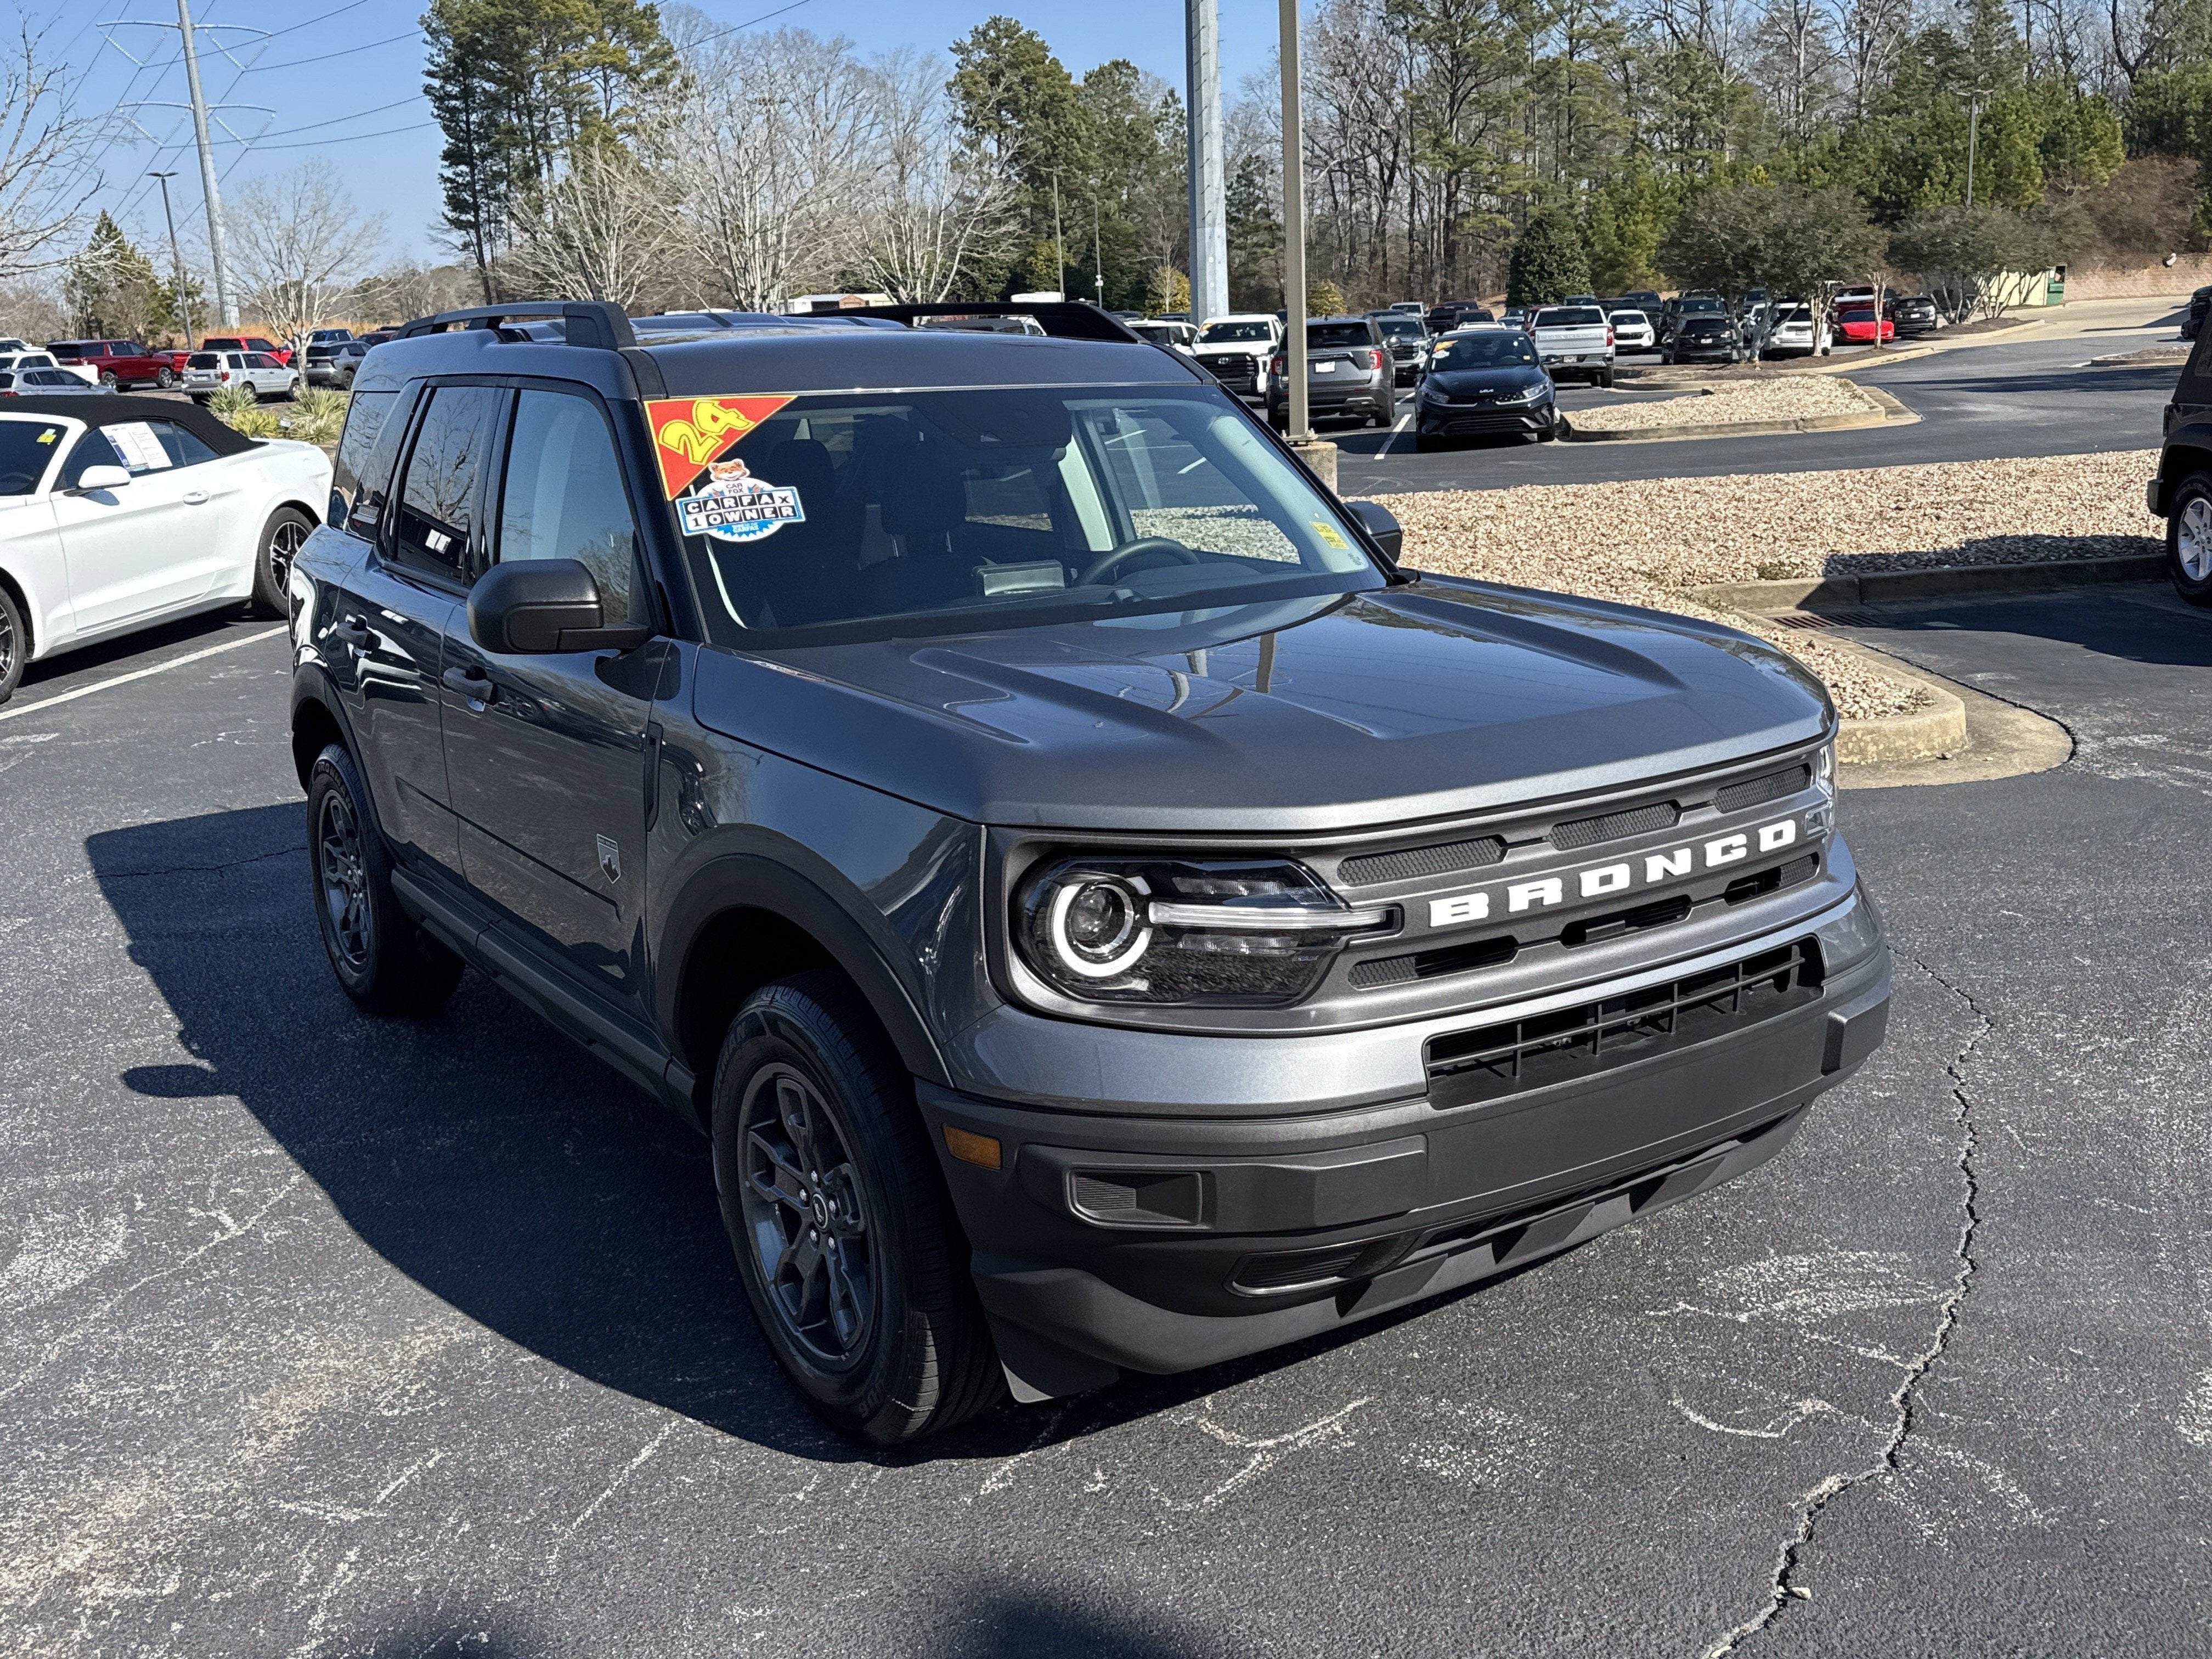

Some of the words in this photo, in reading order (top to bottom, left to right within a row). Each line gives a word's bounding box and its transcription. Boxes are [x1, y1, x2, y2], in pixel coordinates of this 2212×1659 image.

[659, 400, 754, 465] 24
[687, 494, 791, 514] CARFAX
[690, 517, 702, 527] 1
[708, 506, 794, 525] OWNER
[1428, 820, 1796, 928] BRONCO
